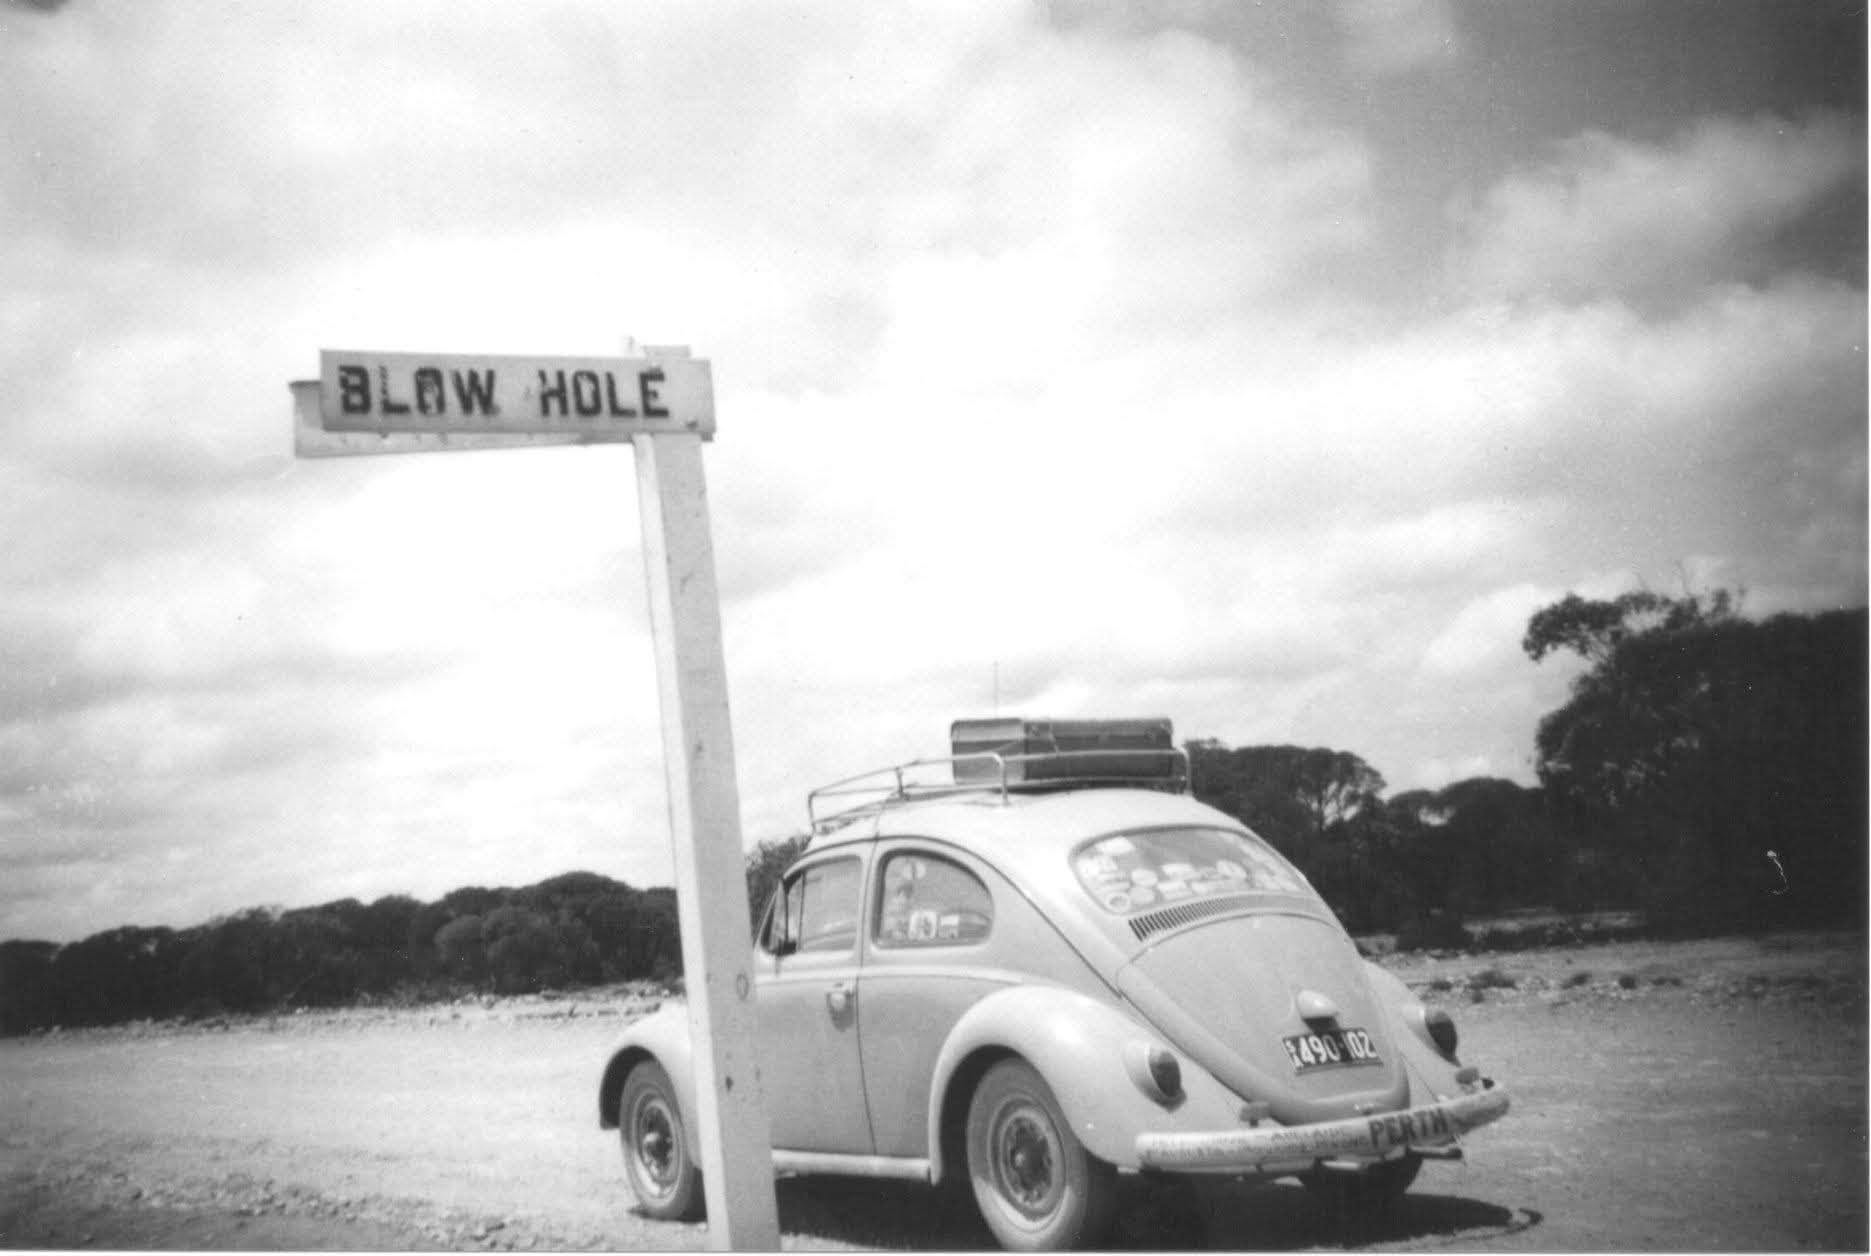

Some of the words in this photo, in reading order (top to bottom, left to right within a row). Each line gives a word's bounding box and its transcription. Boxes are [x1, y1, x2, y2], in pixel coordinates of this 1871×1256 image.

[338, 365, 497, 416] BLOW
[538, 366, 670, 418] HOLE
[1369, 1108, 1449, 1149] PERTH
